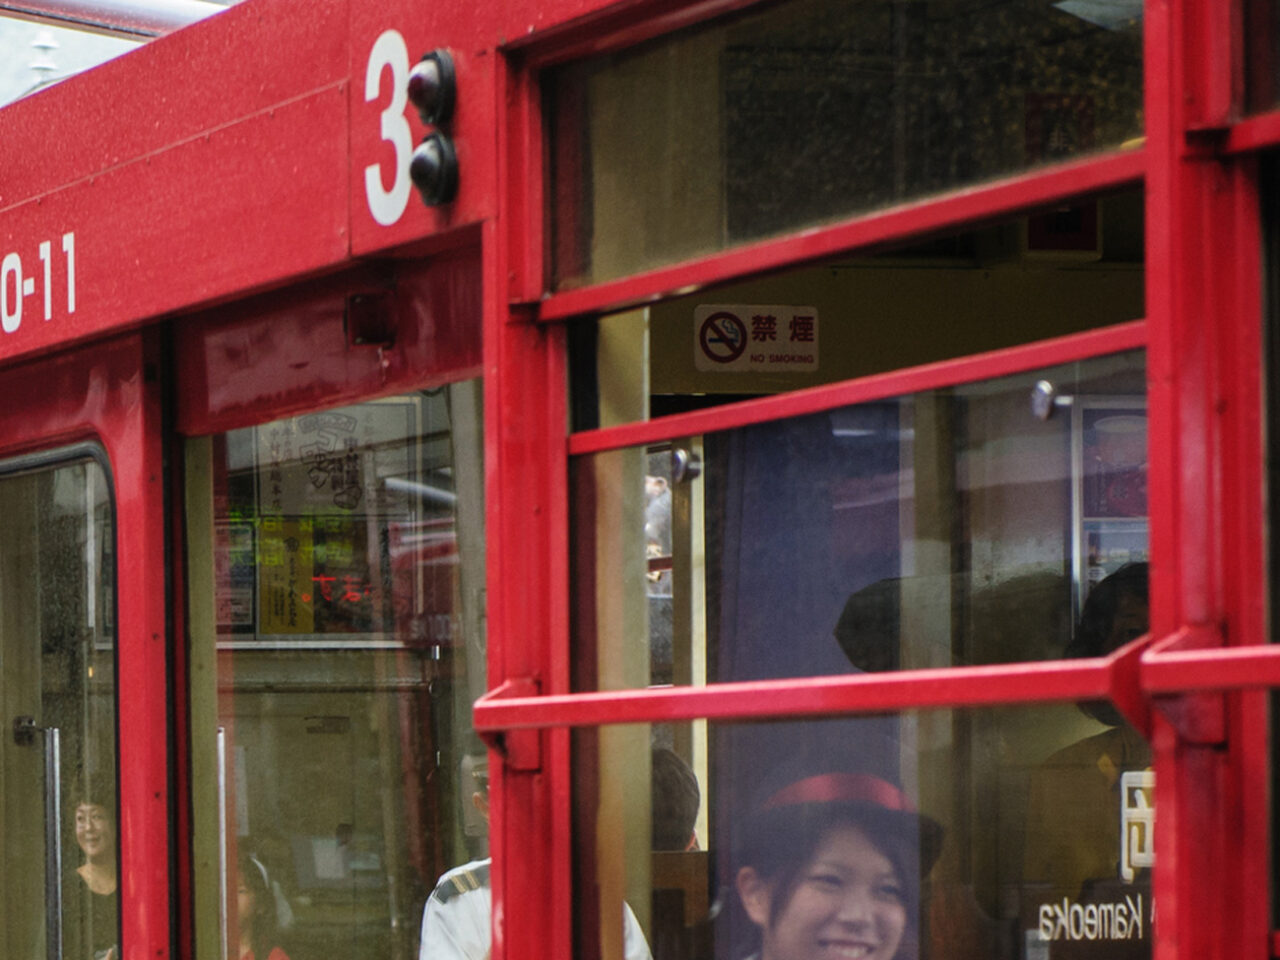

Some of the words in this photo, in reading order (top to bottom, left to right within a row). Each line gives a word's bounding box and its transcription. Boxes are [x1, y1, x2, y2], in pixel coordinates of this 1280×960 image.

[365, 29, 413, 227] 3
[751, 315, 815, 342] 禁煙
[750, 354, 765, 363] NO
[769, 354, 814, 364] SMOKING
